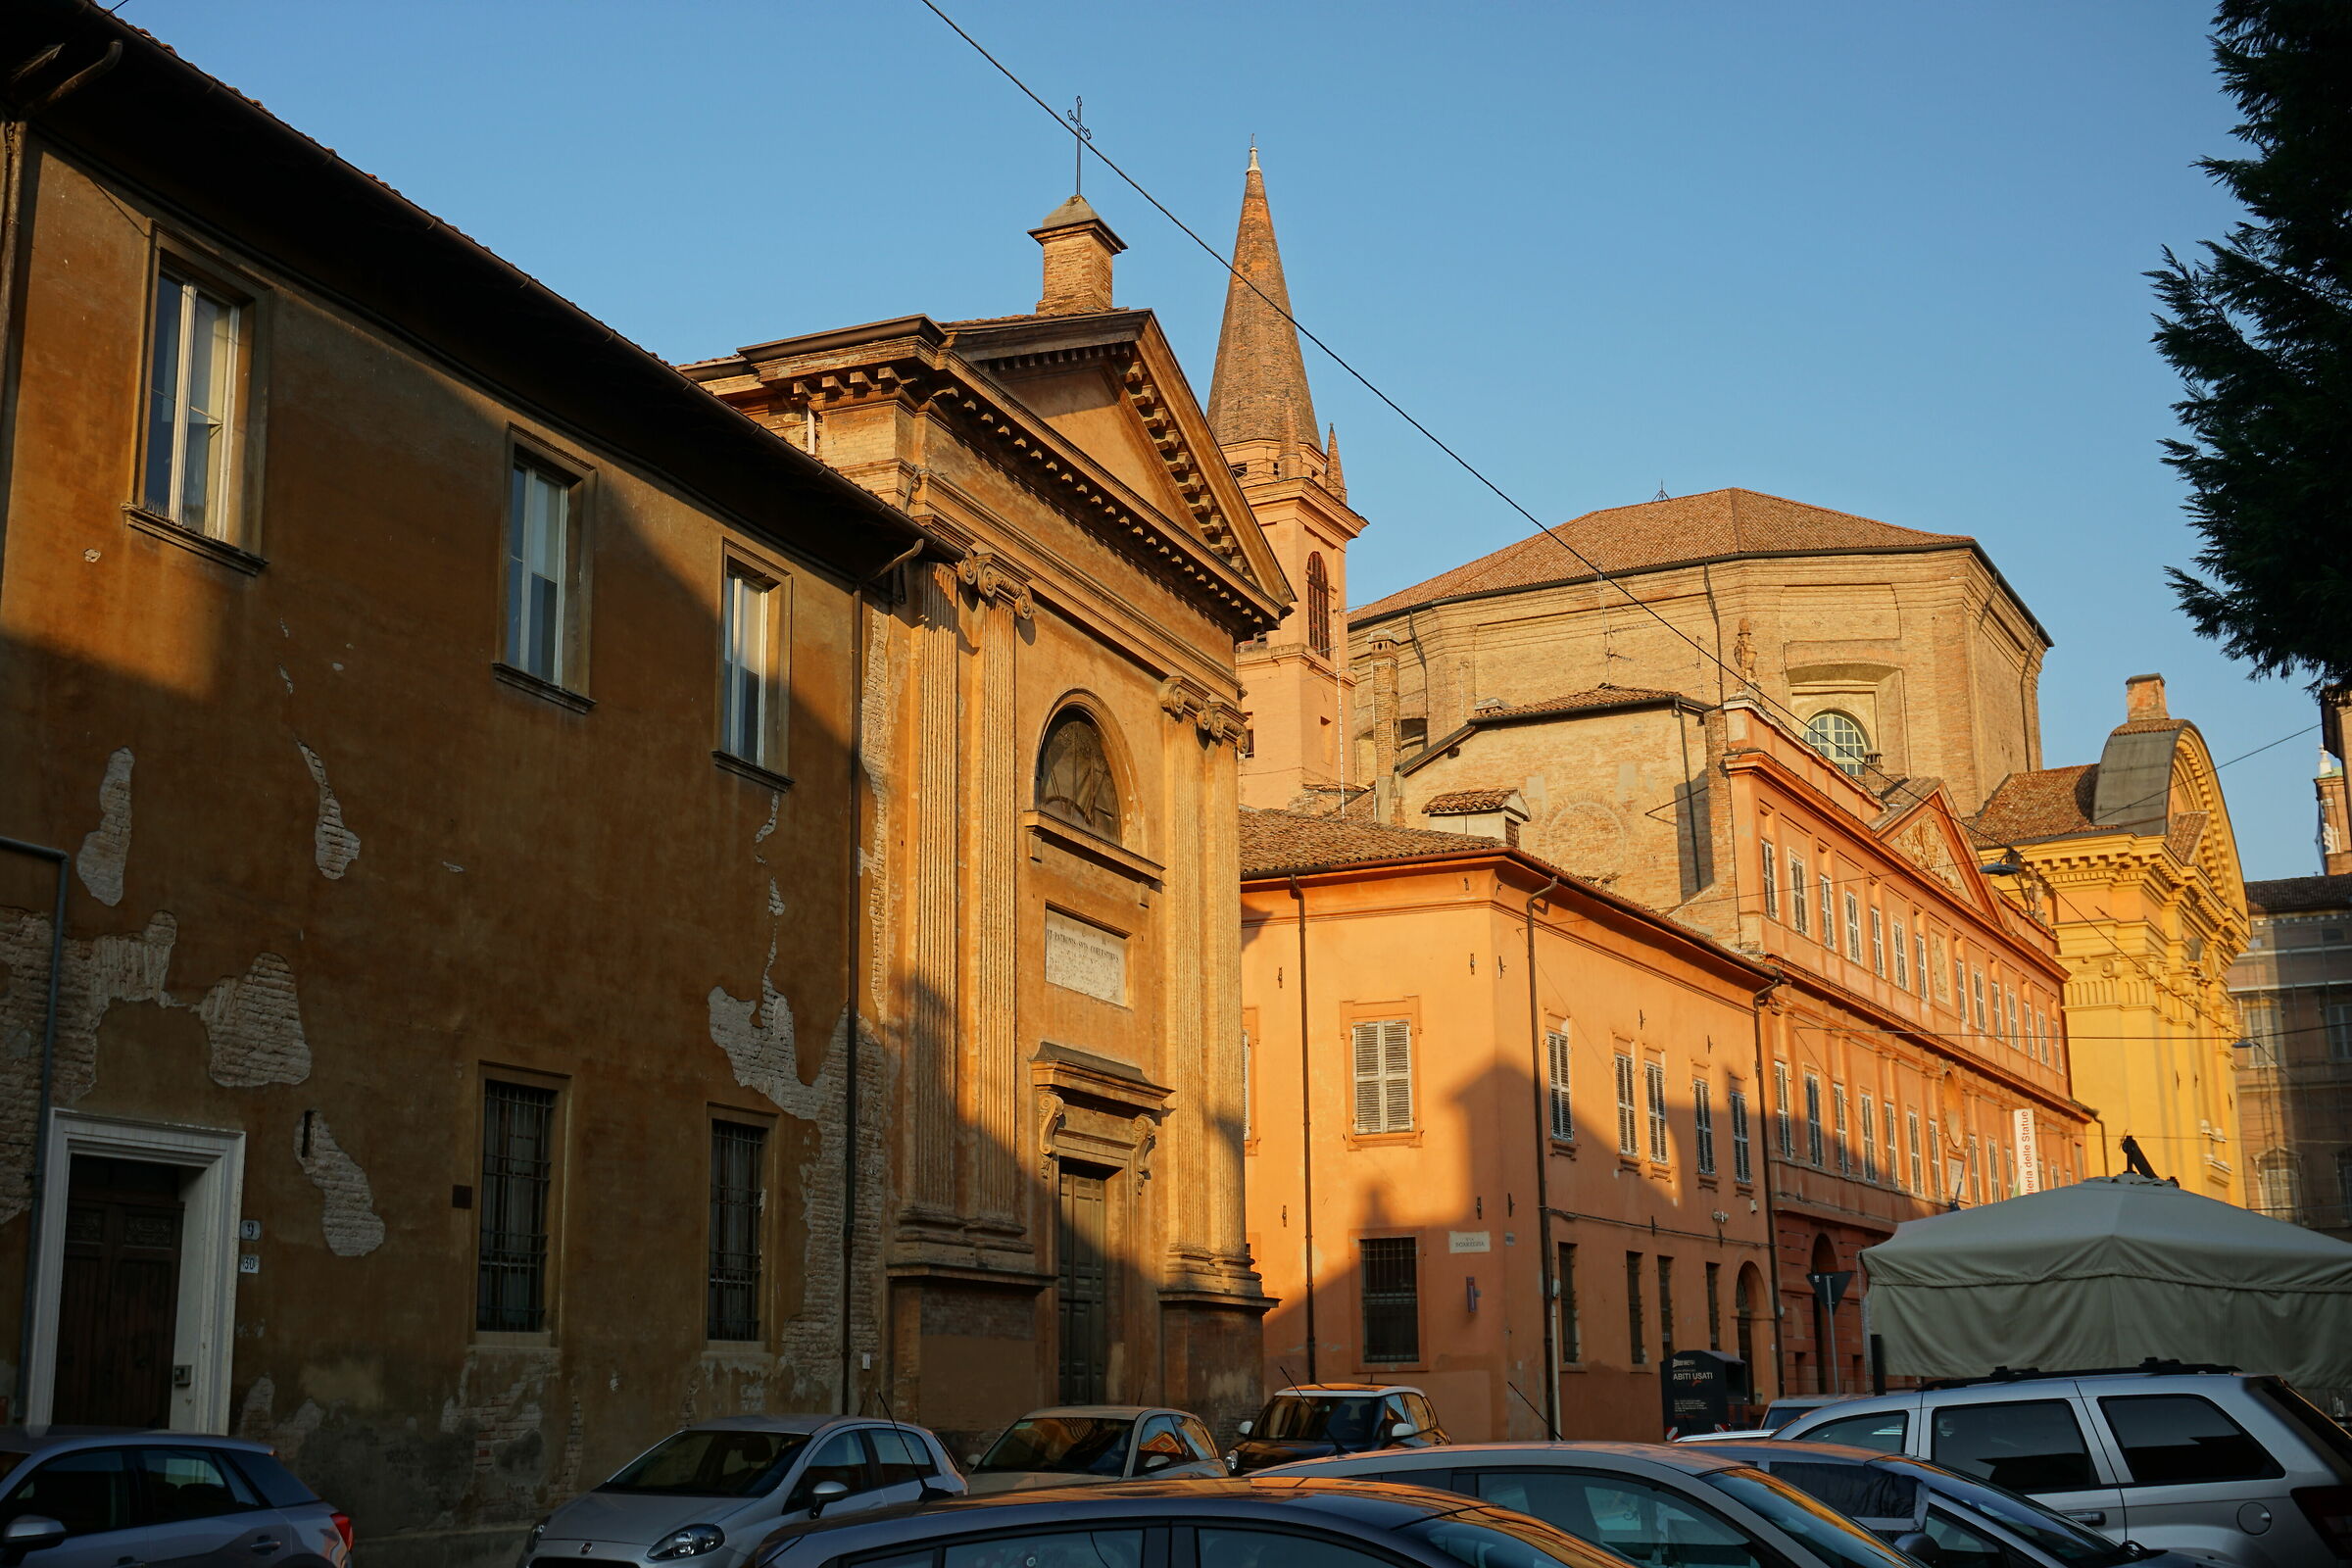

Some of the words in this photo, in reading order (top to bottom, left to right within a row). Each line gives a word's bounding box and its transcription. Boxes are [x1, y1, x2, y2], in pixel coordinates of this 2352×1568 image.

[2021, 1111, 2031, 1143] Statue
[2023, 1146, 2033, 1167] delle
[2025, 1170, 2034, 1195] lleria
[247, 1223, 254, 1236] 9
[244, 1257, 255, 1270] 30
